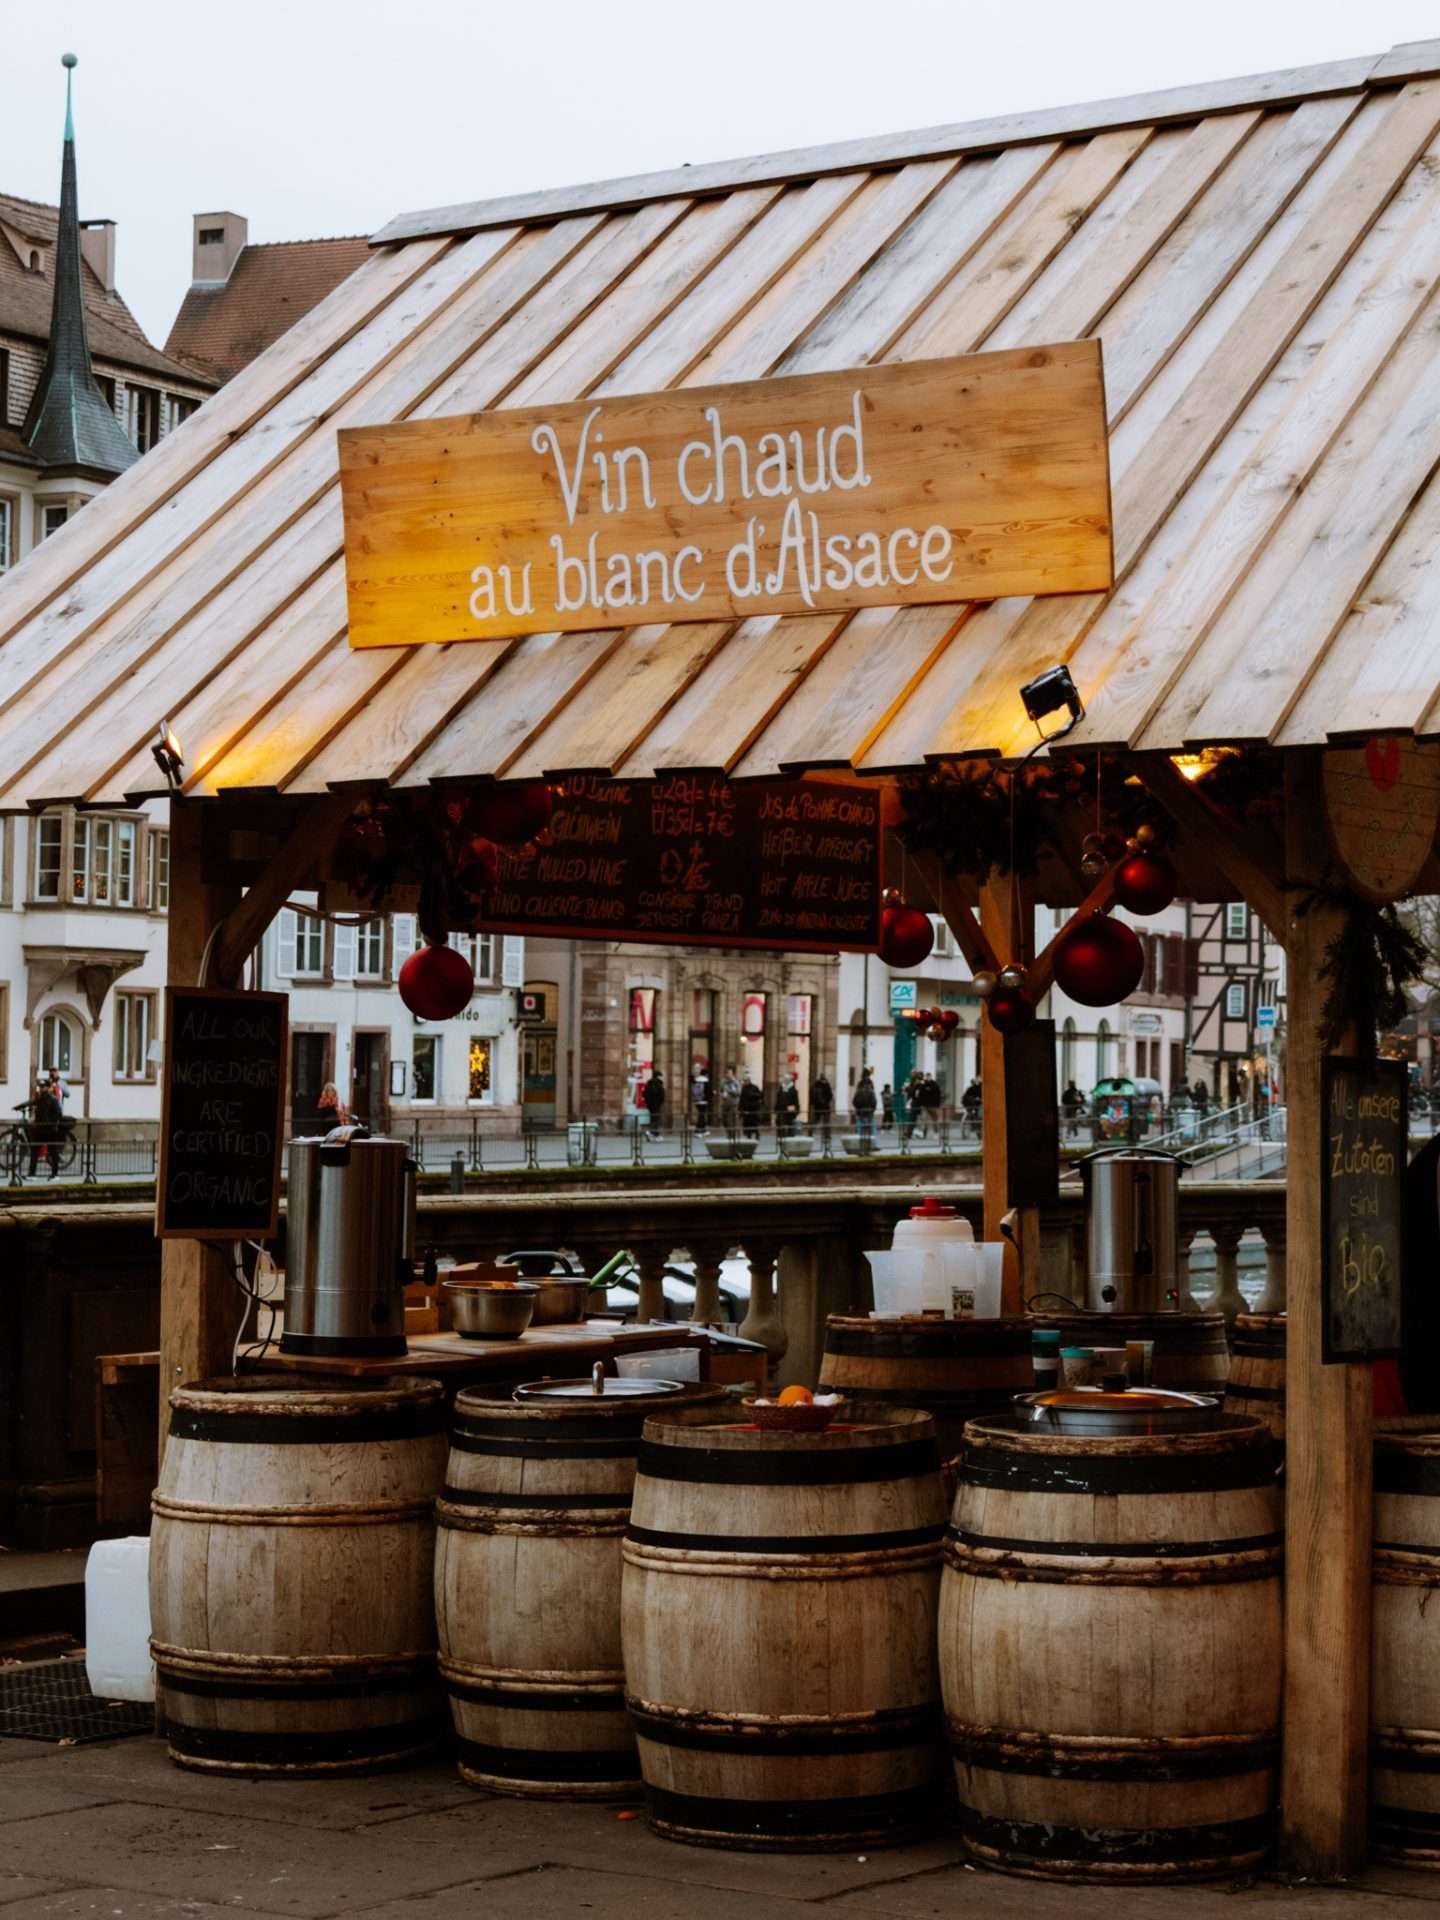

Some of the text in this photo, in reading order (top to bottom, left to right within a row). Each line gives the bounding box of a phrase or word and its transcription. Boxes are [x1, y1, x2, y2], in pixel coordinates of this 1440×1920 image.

[532, 389, 872, 525] Vin chaud
[468, 497, 954, 620] au blanc d'Alsace
[760, 872, 788, 896] HOT
[182, 1009, 226, 1040] ALL
[200, 1100, 244, 1126] ARE
[172, 1128, 271, 1158] CERTIFIED
[1330, 1133, 1395, 1177] Zutaten
[169, 1171, 270, 1210] ORGANIC
[1350, 1183, 1380, 1217] sind
